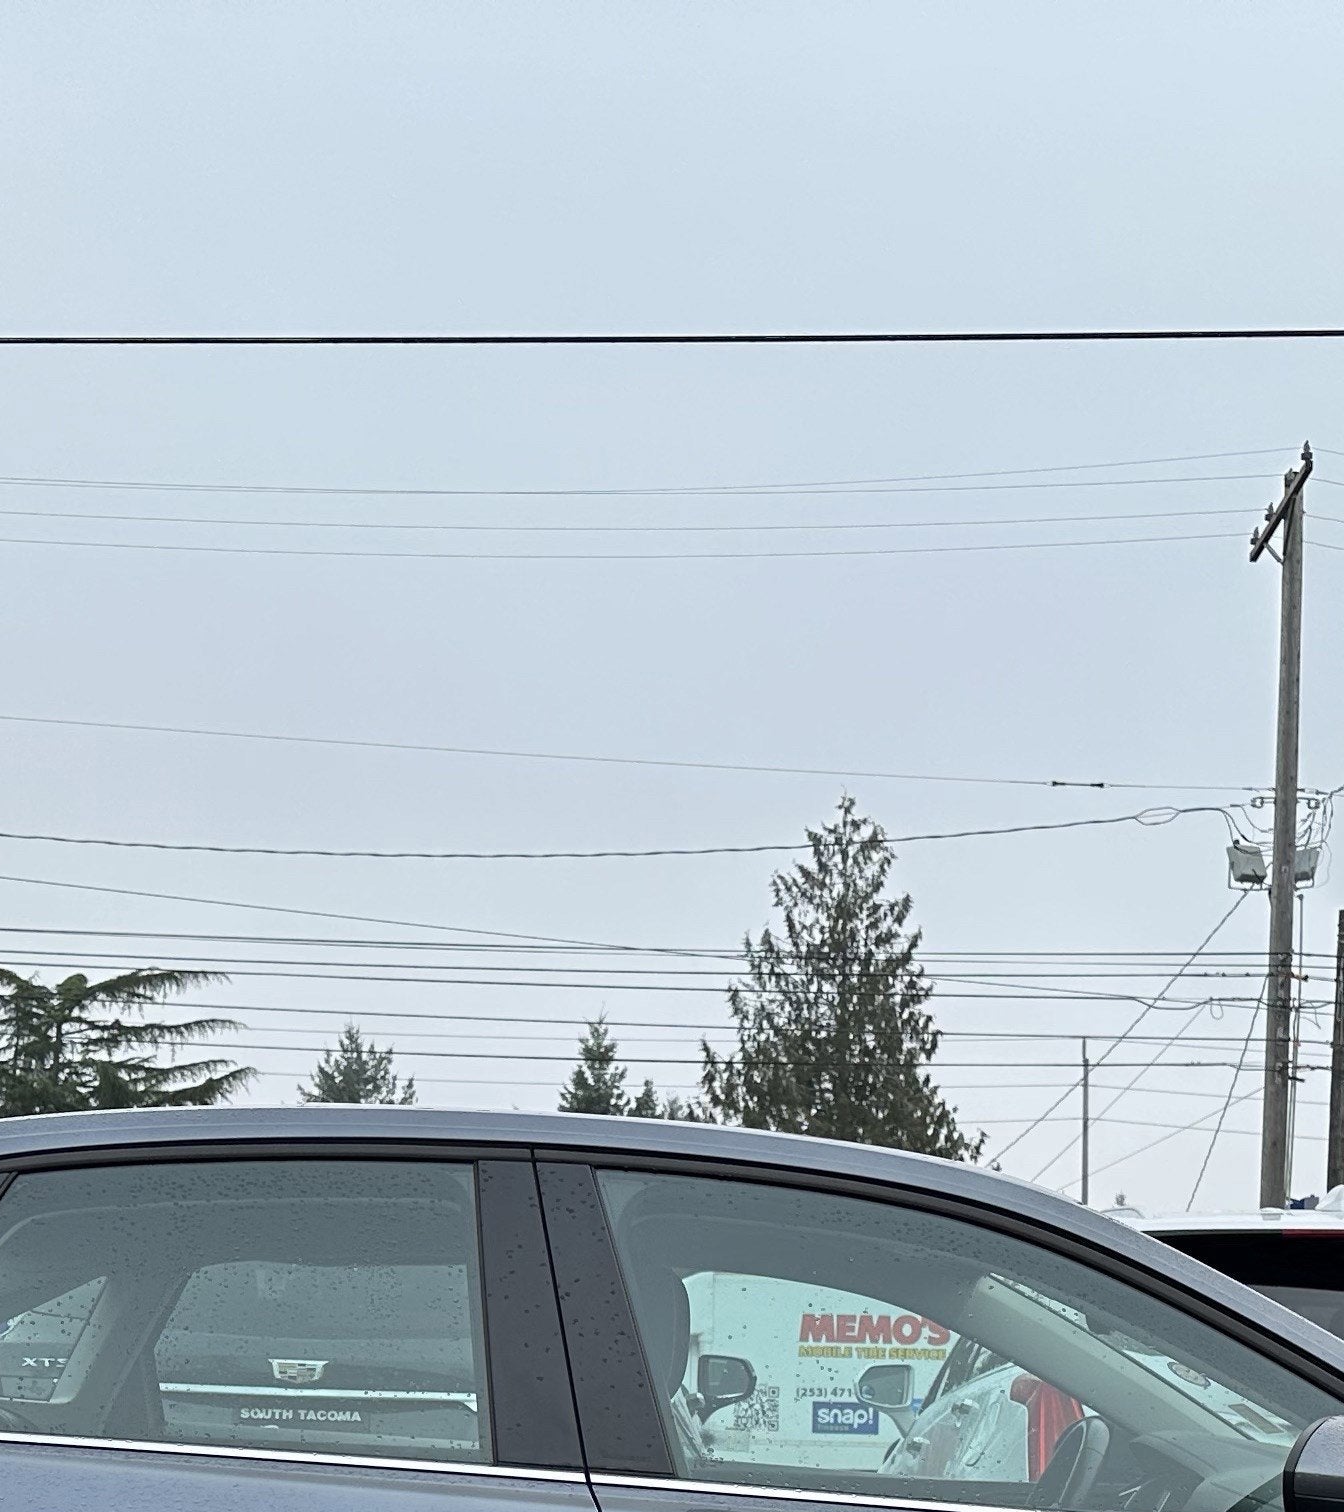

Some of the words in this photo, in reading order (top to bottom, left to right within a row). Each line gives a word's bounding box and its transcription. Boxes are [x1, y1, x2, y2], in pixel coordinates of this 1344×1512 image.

[799, 1314, 950, 1345] MEMO'S
[798, 1345, 852, 1358] MOBILE
[856, 1347, 886, 1359] TIRE
[889, 1348, 946, 1360] SERVICE
[796, 1387, 827, 1399] (253)
[240, 1408, 293, 1420] SOUTH
[298, 1409, 362, 1421] TACOMA
[817, 1407, 873, 1429] snap!
